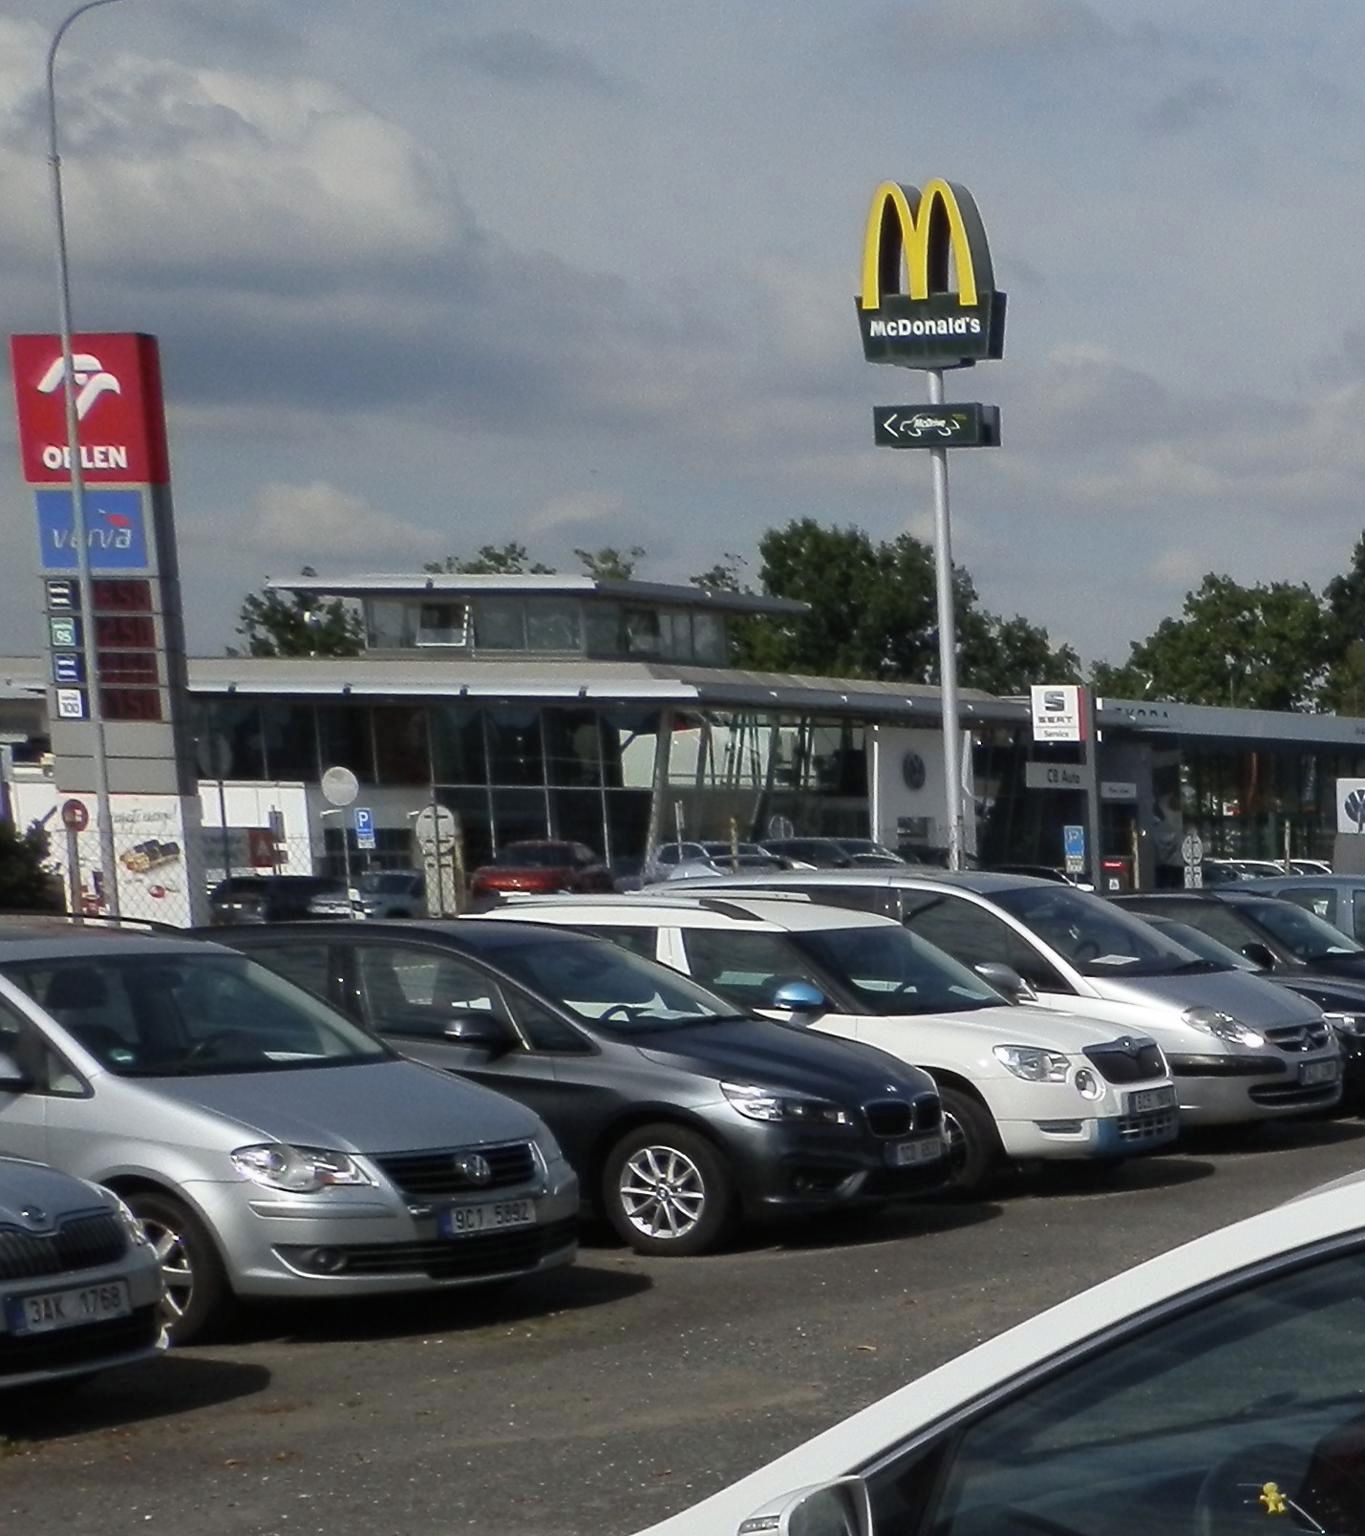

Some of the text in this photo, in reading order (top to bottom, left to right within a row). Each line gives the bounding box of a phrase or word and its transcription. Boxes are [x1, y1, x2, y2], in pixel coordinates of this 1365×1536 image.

[870, 317, 981, 337] McDonald's
[1038, 716, 1073, 724] SEAT
[1044, 729, 1070, 738] Service
[358, 811, 369, 827] P
[455, 1208, 484, 1230] 9C1
